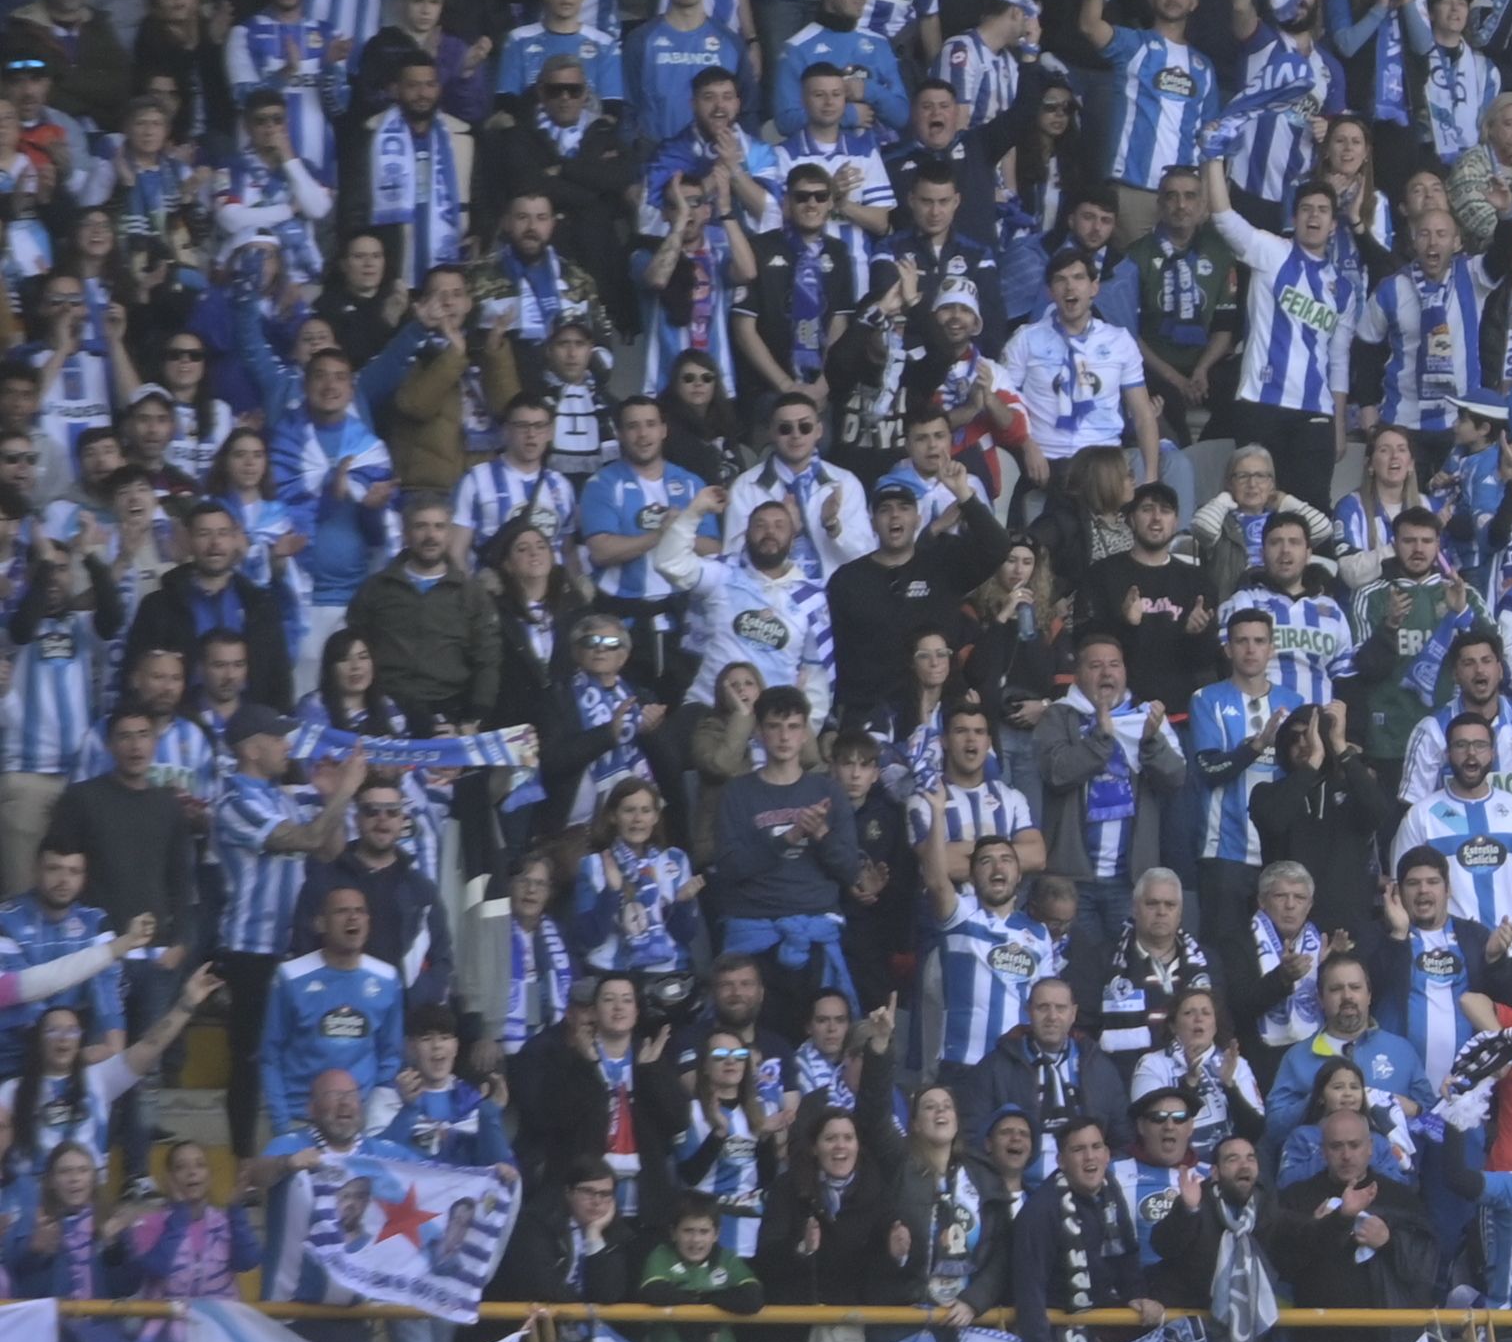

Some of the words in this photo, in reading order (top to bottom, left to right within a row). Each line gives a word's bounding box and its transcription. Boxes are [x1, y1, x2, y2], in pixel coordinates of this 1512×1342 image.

[1274, 628, 1335, 654] EIRACO
[1464, 846, 1498, 856] Estrella
[1464, 855, 1498, 865] Galicia
